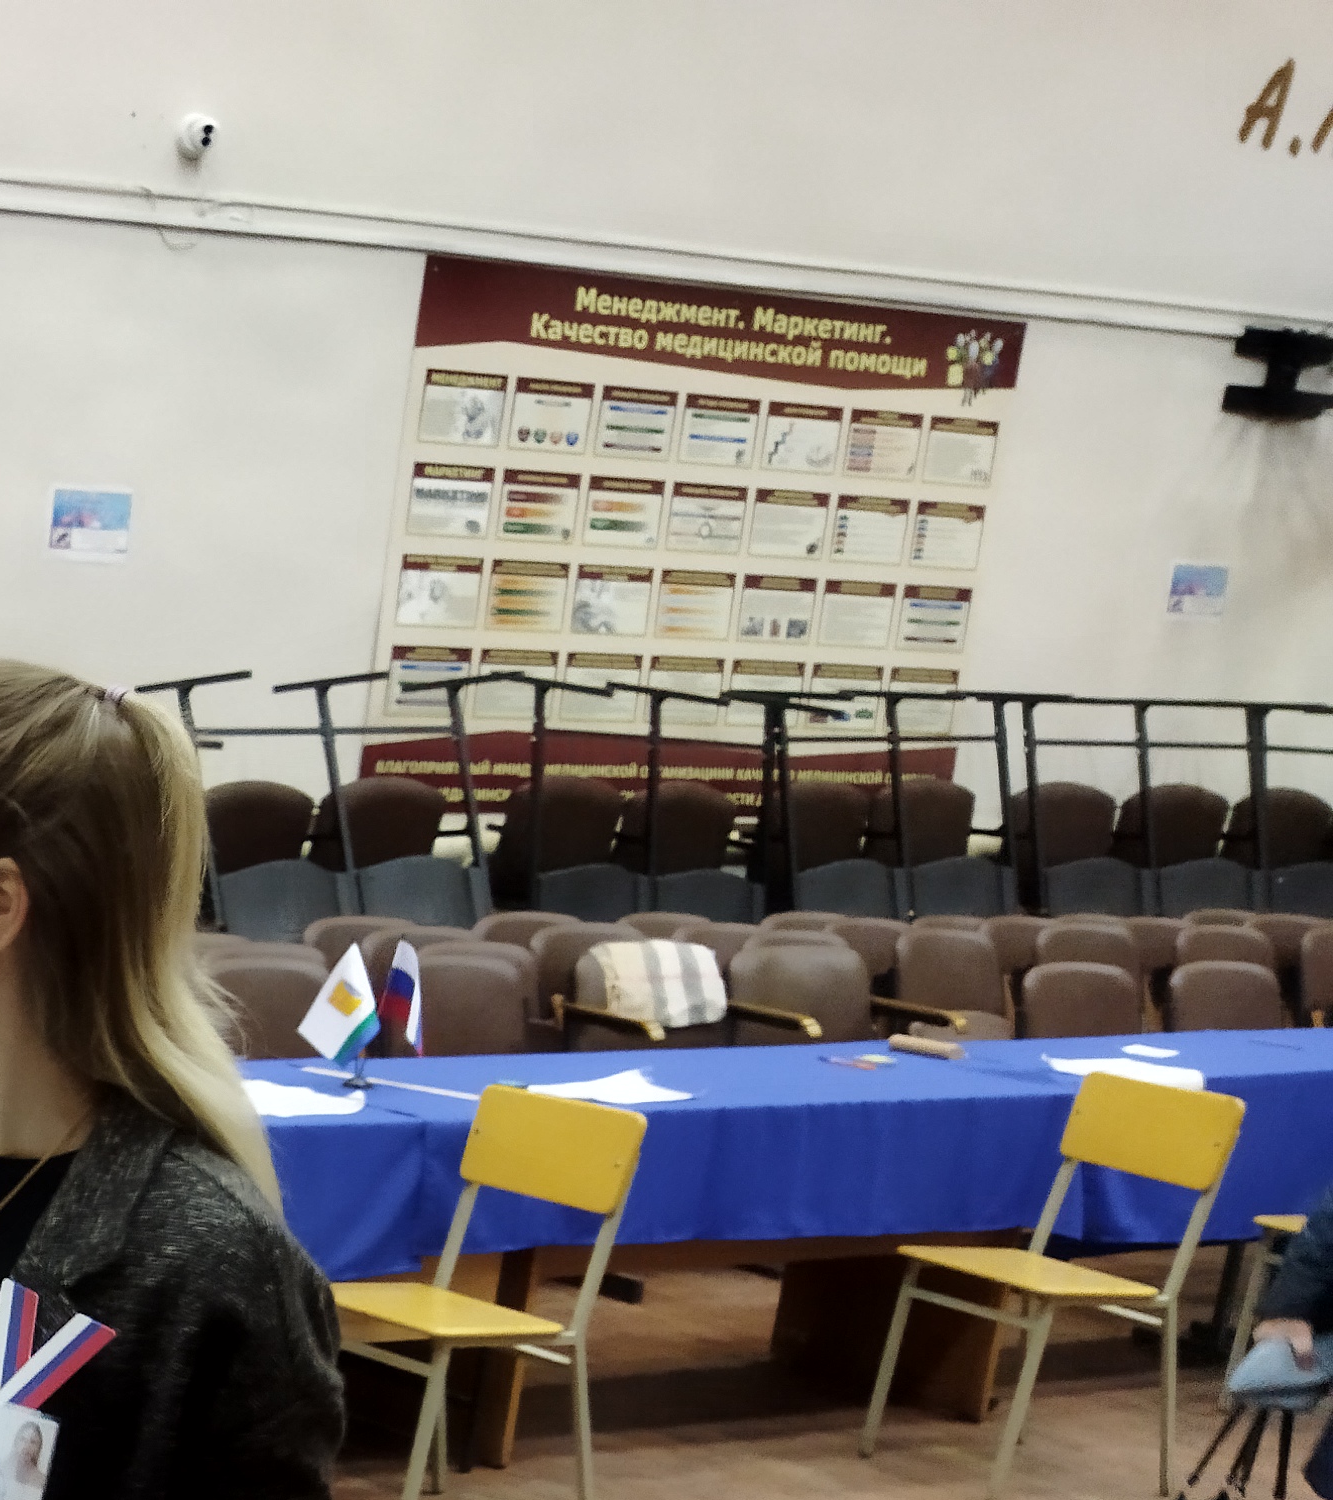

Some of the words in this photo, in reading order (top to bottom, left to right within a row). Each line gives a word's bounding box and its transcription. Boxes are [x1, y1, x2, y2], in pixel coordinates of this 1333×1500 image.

[529, 312, 649, 351] Качество
[654, 330, 823, 368] медицинской
[829, 348, 928, 380] помощи
[575, 286, 745, 330] Менеджмент.
[752, 306, 893, 345] Маркетинг.
